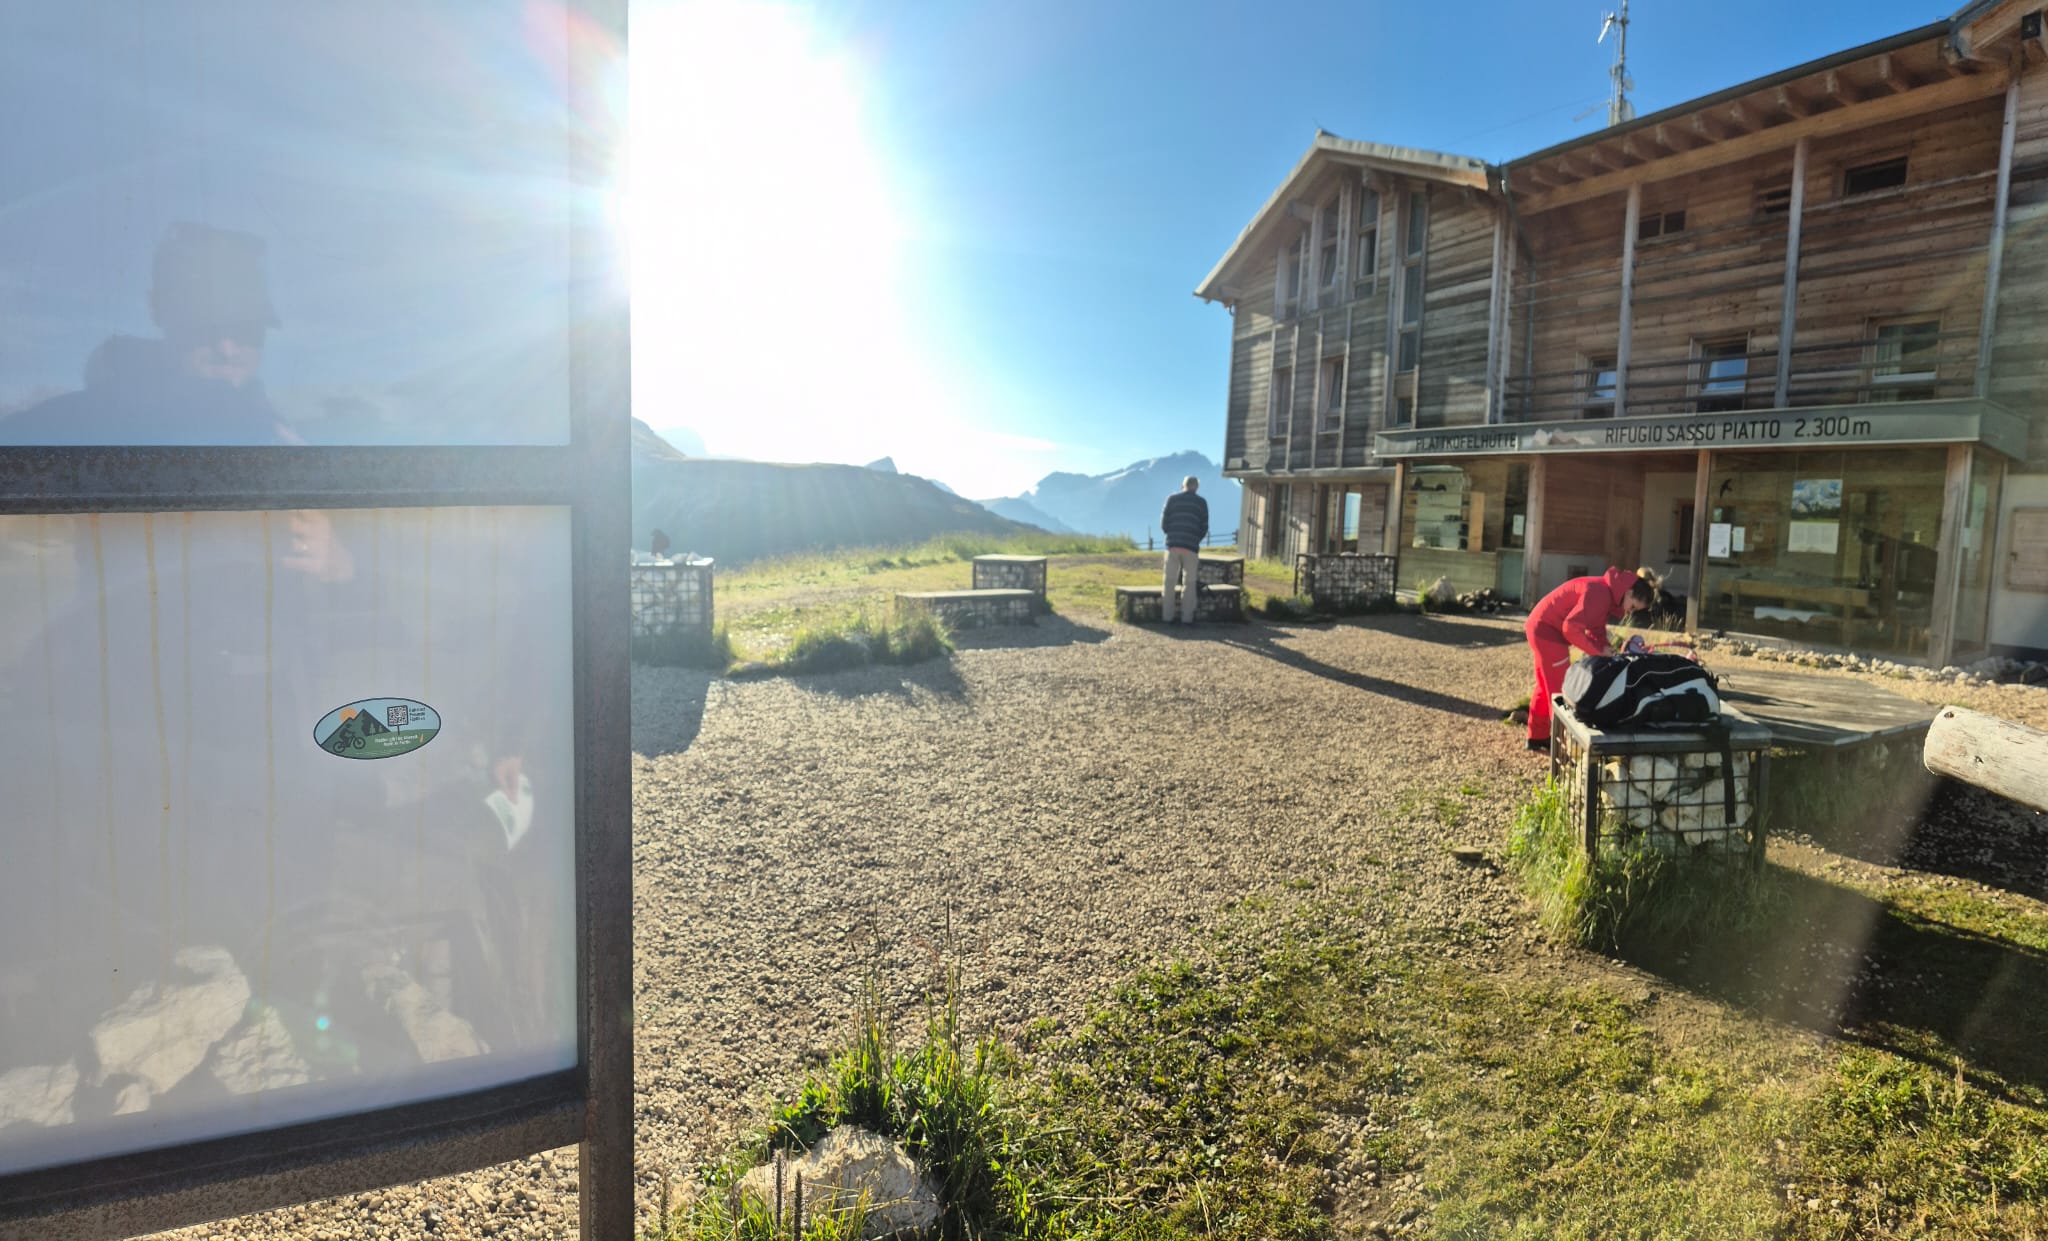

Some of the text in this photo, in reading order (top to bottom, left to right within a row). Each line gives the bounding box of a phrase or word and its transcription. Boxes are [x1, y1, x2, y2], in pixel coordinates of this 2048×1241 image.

[1415, 431, 1516, 451] PLATTKOFELHÜTTE
[1605, 426, 1662, 444] RIFUGIO
[1666, 423, 1715, 442] SASSO
[1722, 419, 1780, 440] PIATTO
